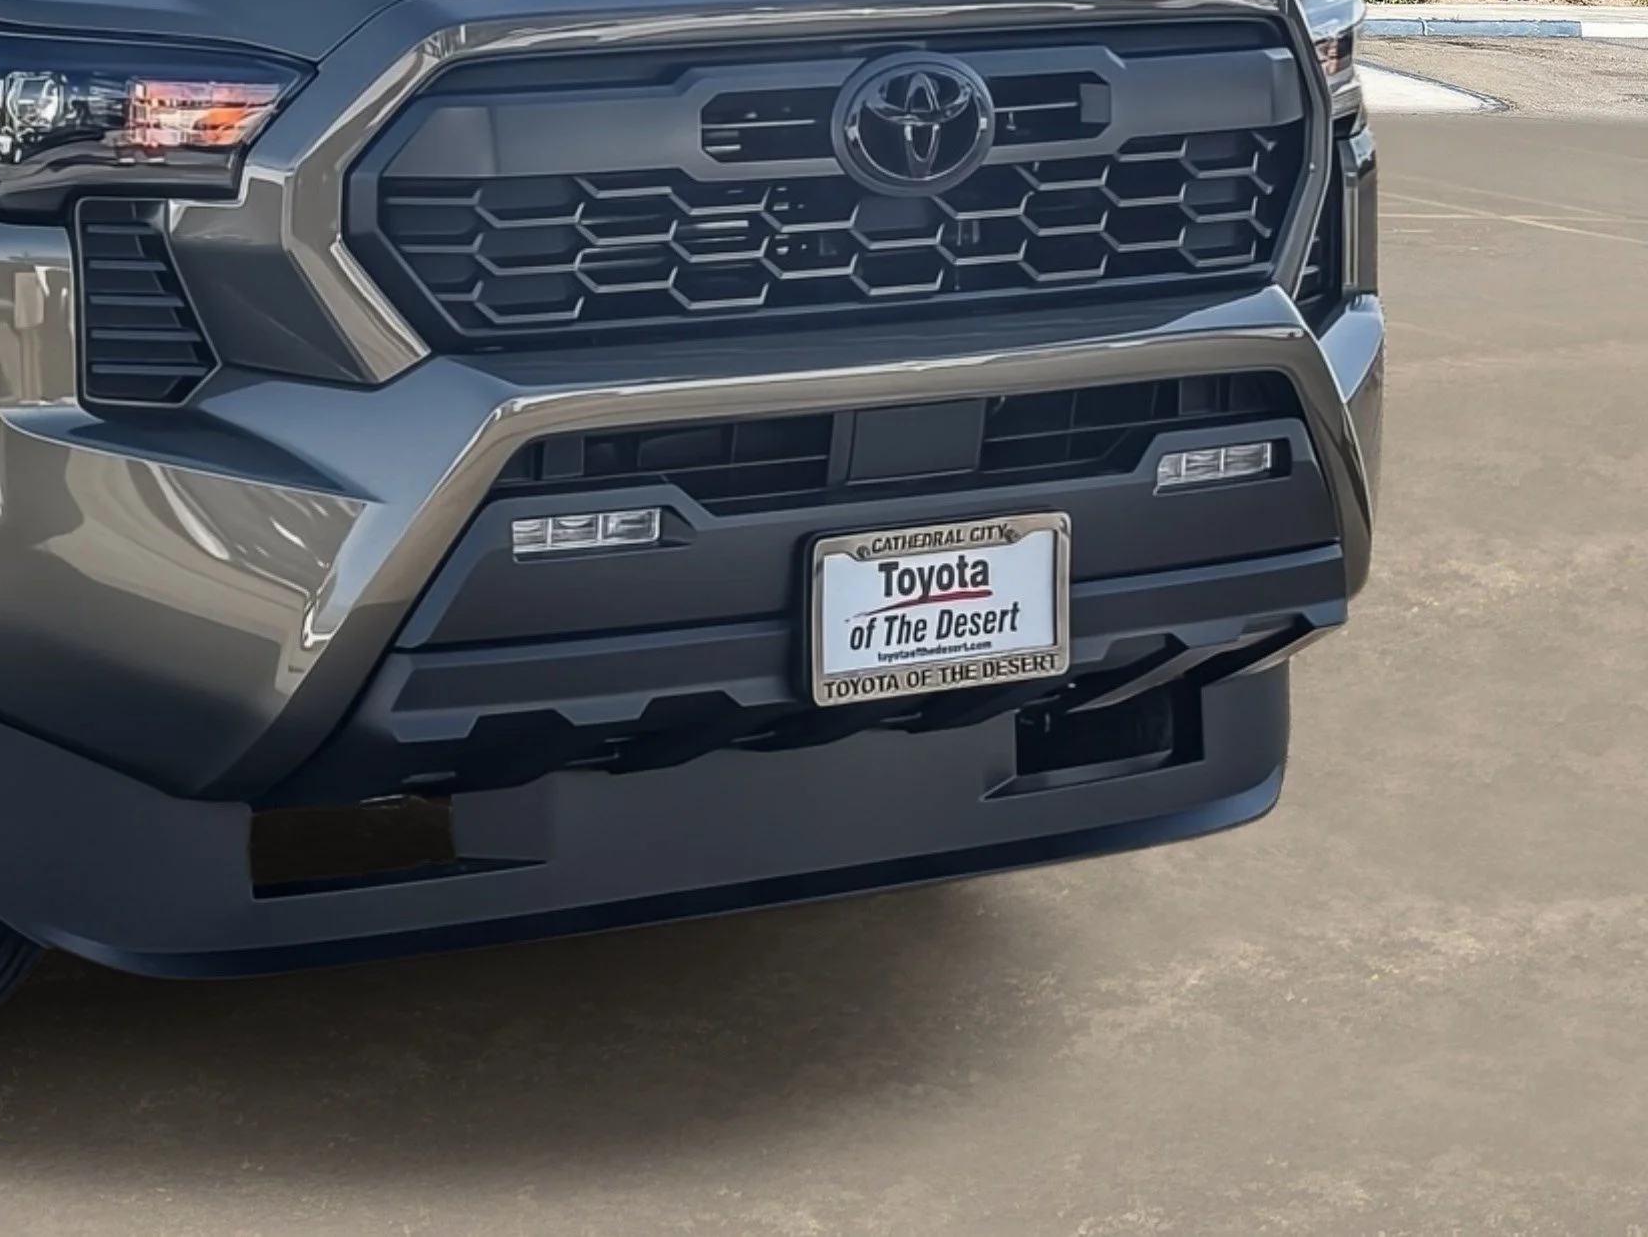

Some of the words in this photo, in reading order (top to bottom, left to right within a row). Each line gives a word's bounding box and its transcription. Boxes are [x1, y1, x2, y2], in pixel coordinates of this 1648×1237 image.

[871, 529, 965, 554] CATHEDRAL
[970, 523, 1007, 542] CITY
[878, 555, 990, 598] Toyota
[850, 616, 877, 650] of
[884, 613, 927, 647] The
[936, 601, 1021, 640] Desert
[824, 674, 899, 699] TOYOTA
[906, 669, 935, 688] OF
[941, 664, 977, 683] THE
[982, 654, 1060, 678] DESERT
